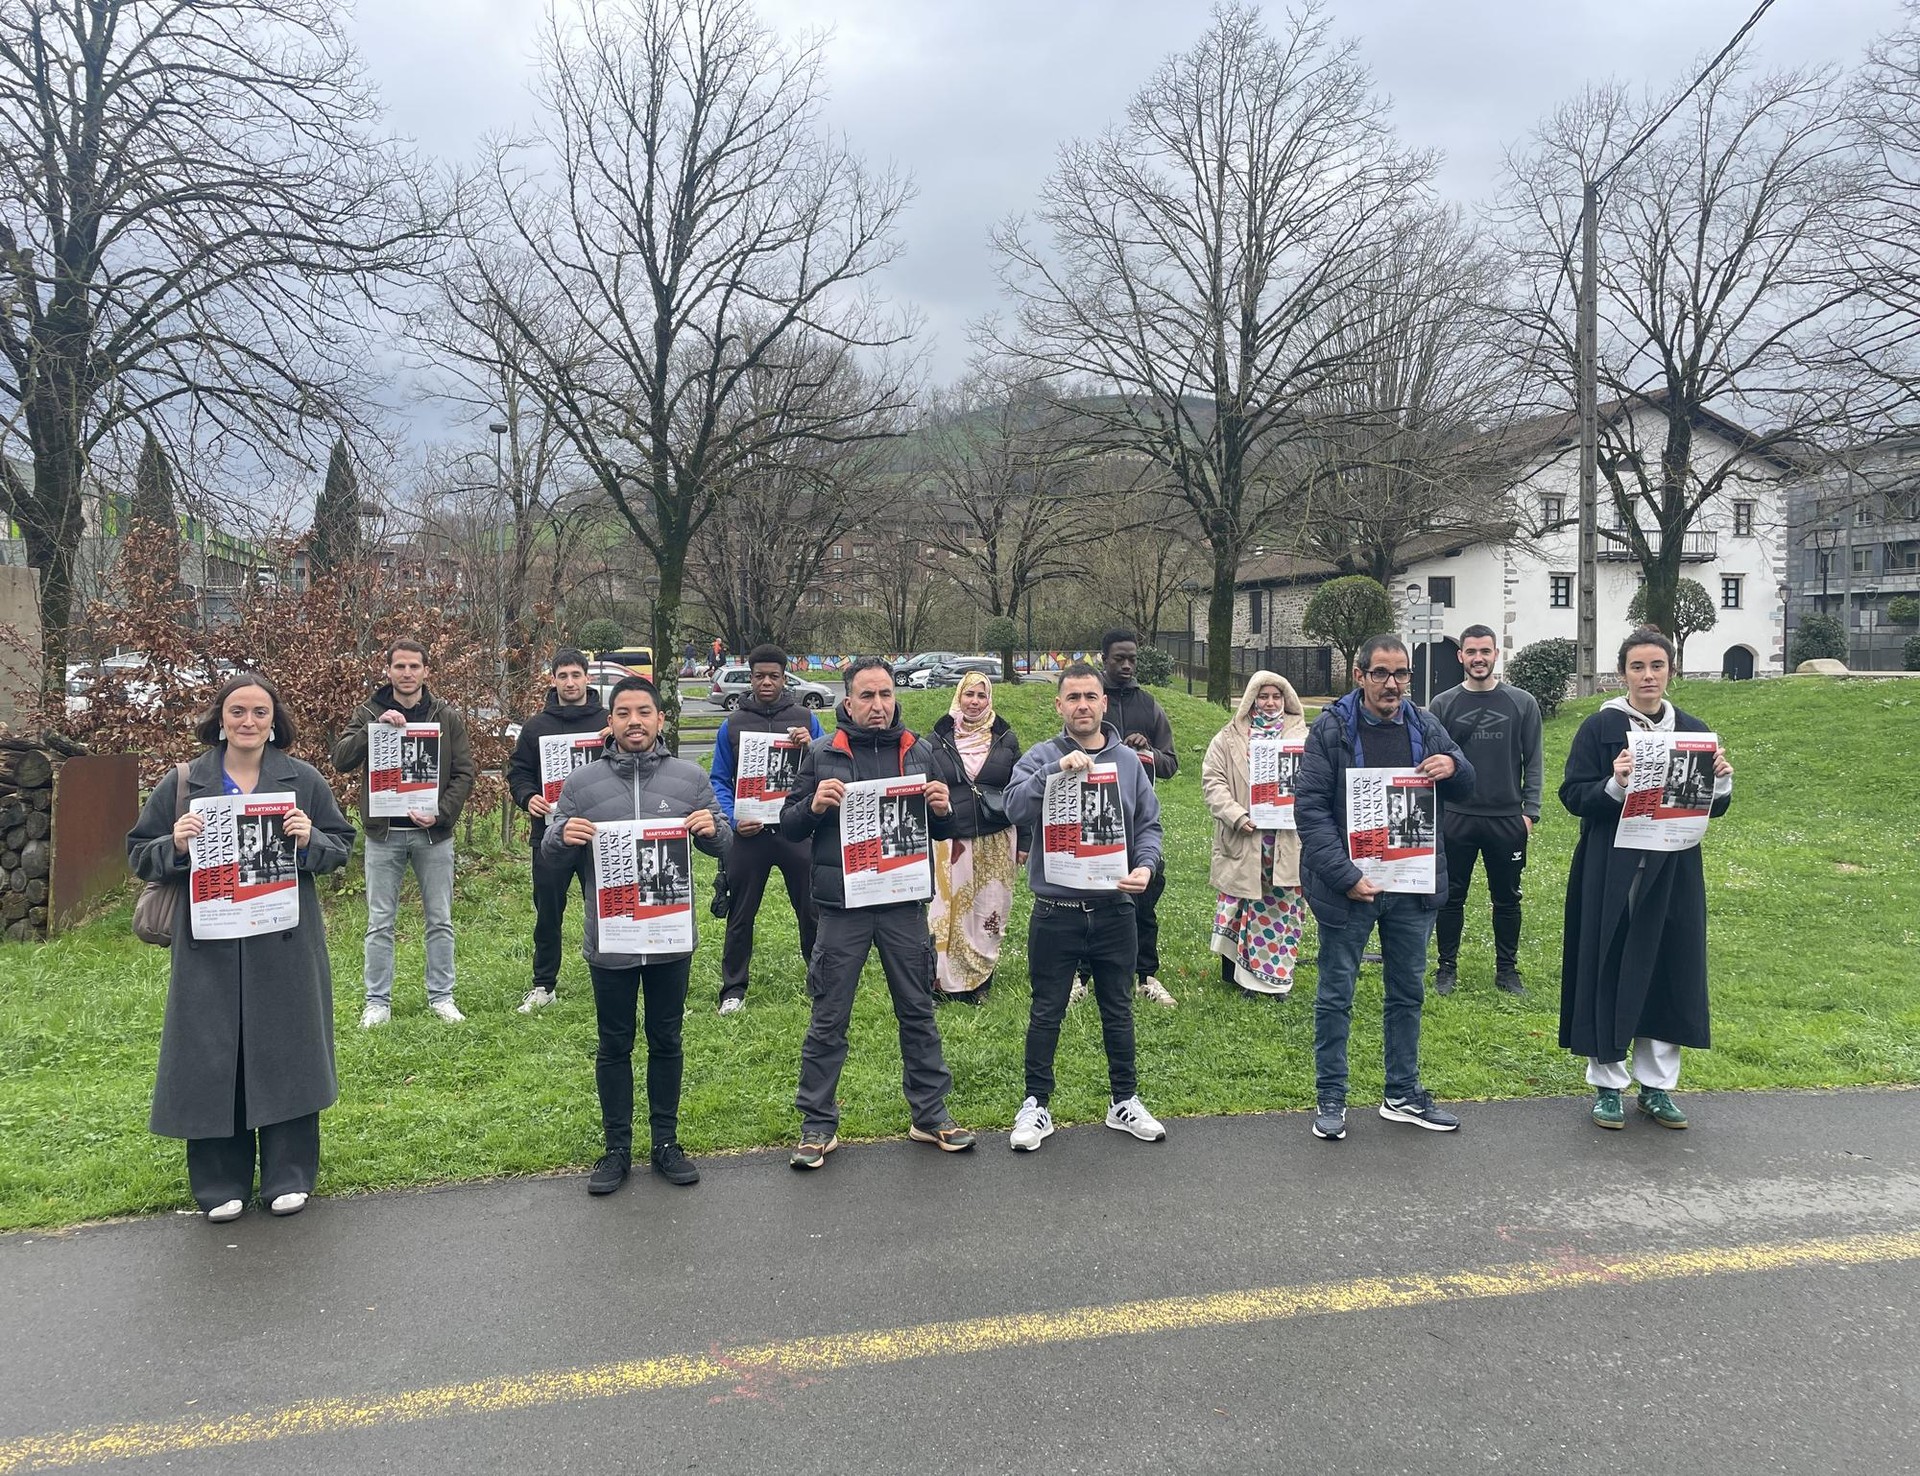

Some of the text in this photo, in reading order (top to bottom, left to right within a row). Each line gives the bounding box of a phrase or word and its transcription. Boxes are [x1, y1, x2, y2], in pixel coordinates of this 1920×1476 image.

[1471, 730, 1504, 739] mbro
[248, 805, 281, 813] MARTXOAK
[645, 829, 675, 837] MARTXOAK
[856, 790, 865, 821] KLASE
[196, 808, 208, 902] ARRAZAKERIN
[206, 806, 221, 901] AURREAN KLASE
[220, 805, 235, 901] ELKARTASUNA.
[599, 831, 613, 918] ARRAZAKERIAREN
[609, 830, 623, 918] AURREAN KLASE
